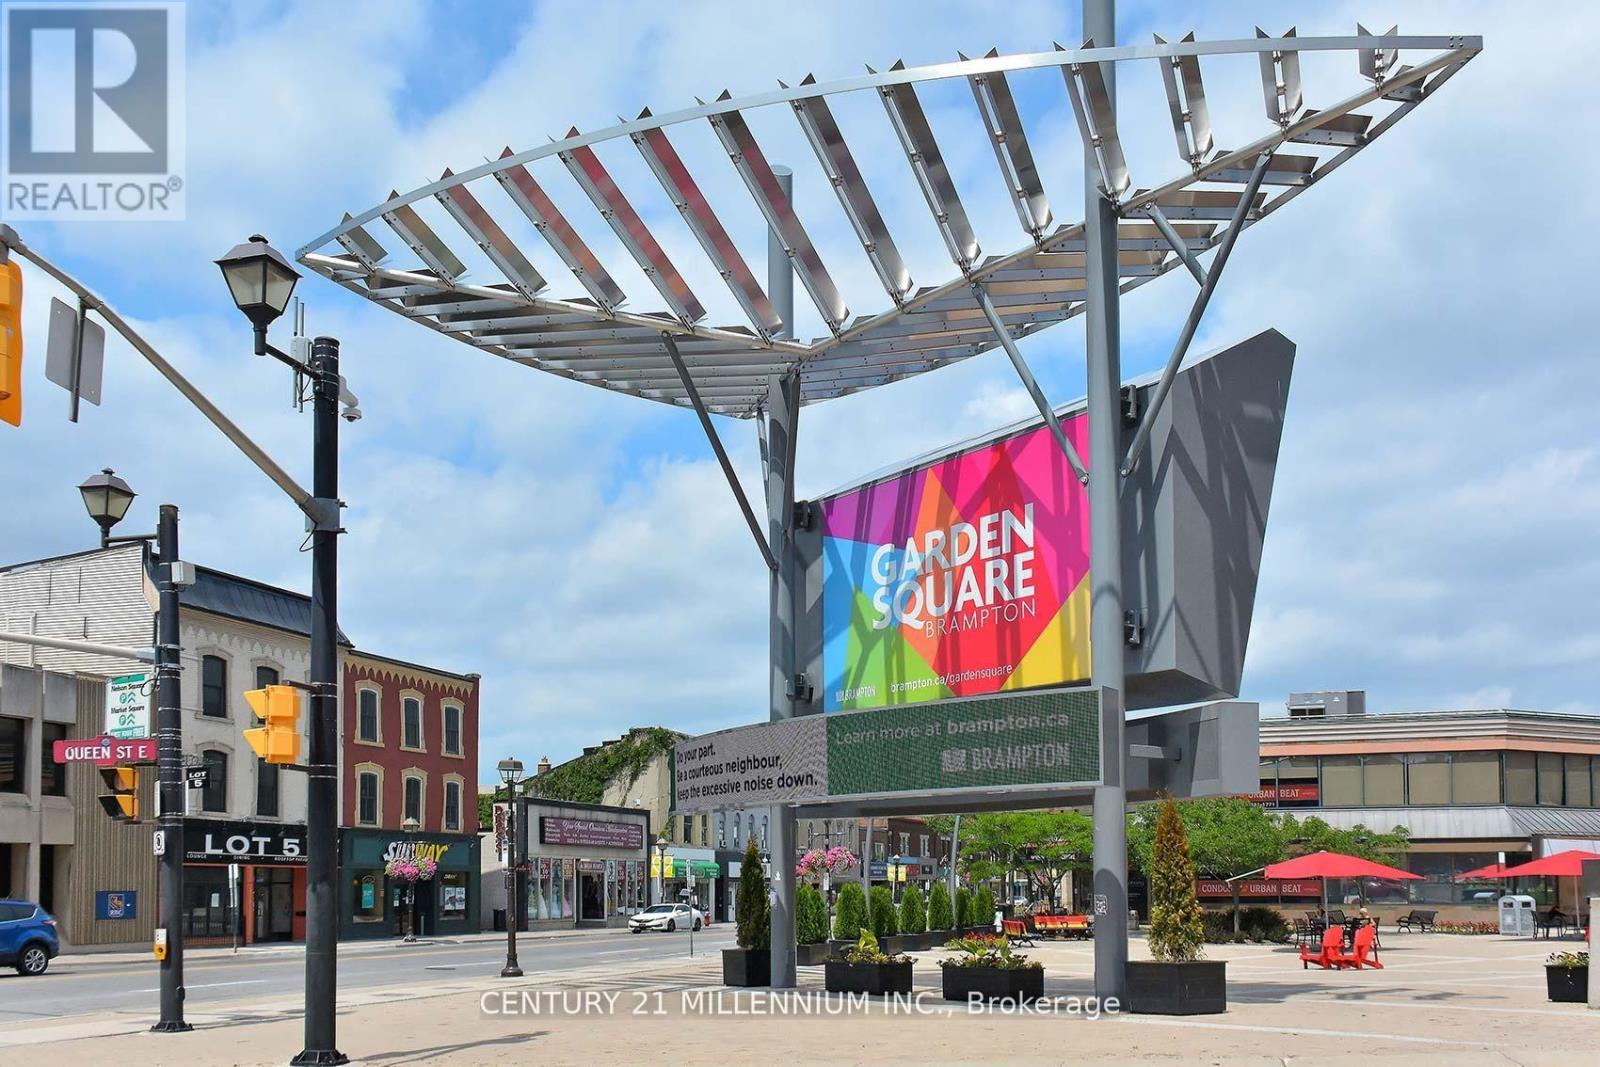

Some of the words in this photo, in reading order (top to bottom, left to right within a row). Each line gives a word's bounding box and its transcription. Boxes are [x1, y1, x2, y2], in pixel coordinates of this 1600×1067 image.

[871, 502, 1035, 586] GARDEN
[872, 550, 1035, 630] SQUARE
[925, 599, 1037, 639] BRAMPTON
[890, 664, 1012, 693] brampton.ca/gardensquare
[837, 727, 876, 745] Learn
[879, 726, 920, 741] more
[926, 721, 941, 737] at
[947, 712, 1069, 737] brampton.ca
[64, 746, 111, 760] QUEEN
[116, 745, 133, 759] ST
[138, 745, 147, 759] E
[683, 748, 697, 764] your
[698, 743, 716, 760] part.
[972, 742, 1070, 771] BRAMPTON
[188, 771, 207, 779] LOT
[683, 769, 688, 781] a
[688, 763, 723, 780] courteous
[725, 753, 783, 775] neighbour,
[194, 779, 203, 787] 5
[690, 784, 700, 799] the
[701, 778, 741, 796] excessive
[743, 775, 773, 792] noise
[777, 772, 818, 789] down.
[1280, 789, 1300, 798] BEAT
[205, 834, 271, 856] LOT
[282, 838, 301, 857] 5
[383, 841, 449, 862] SUBWAY
[1250, 884, 1277, 893] URBAN
[1282, 884, 1301, 893] BEAT
